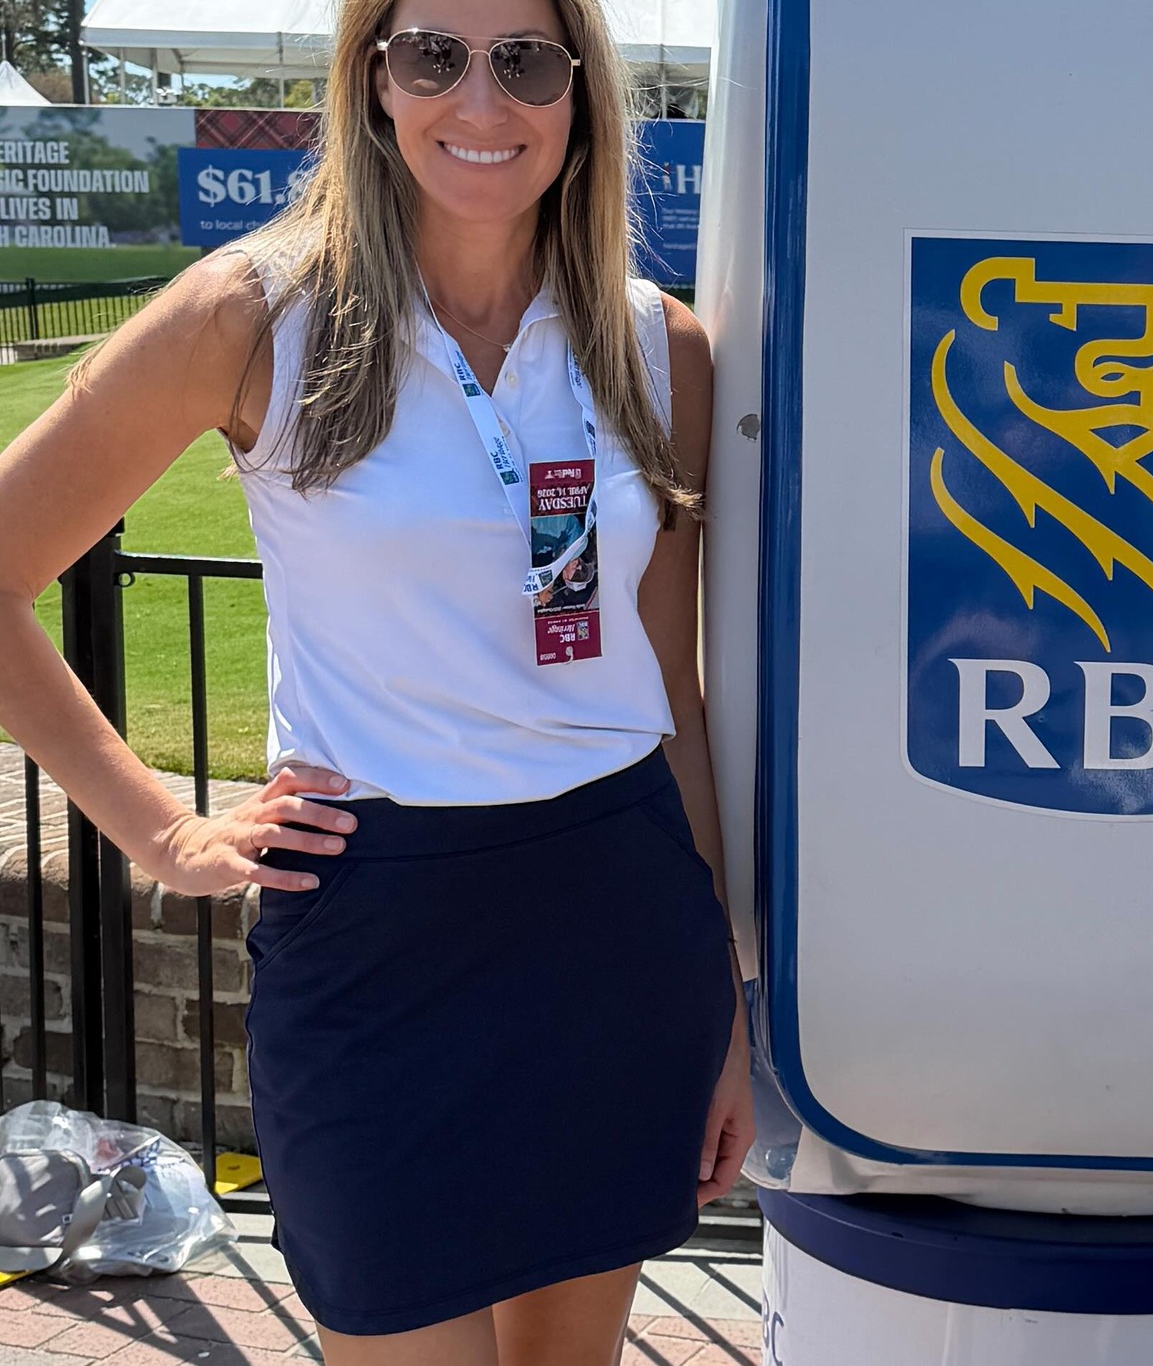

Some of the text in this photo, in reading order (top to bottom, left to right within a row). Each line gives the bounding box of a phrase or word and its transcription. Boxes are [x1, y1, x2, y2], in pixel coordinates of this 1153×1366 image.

[27, 169, 150, 193] FOUNDATION
[0, 197, 79, 220] LIVES IN
[200, 221, 213, 230] to
[215, 220, 244, 230] local
[14, 225, 117, 248] CAROLINA.
[490, 450, 505, 470] RBC
[538, 495, 588, 511] TUESDAY
[559, 632, 576, 644] RBC
